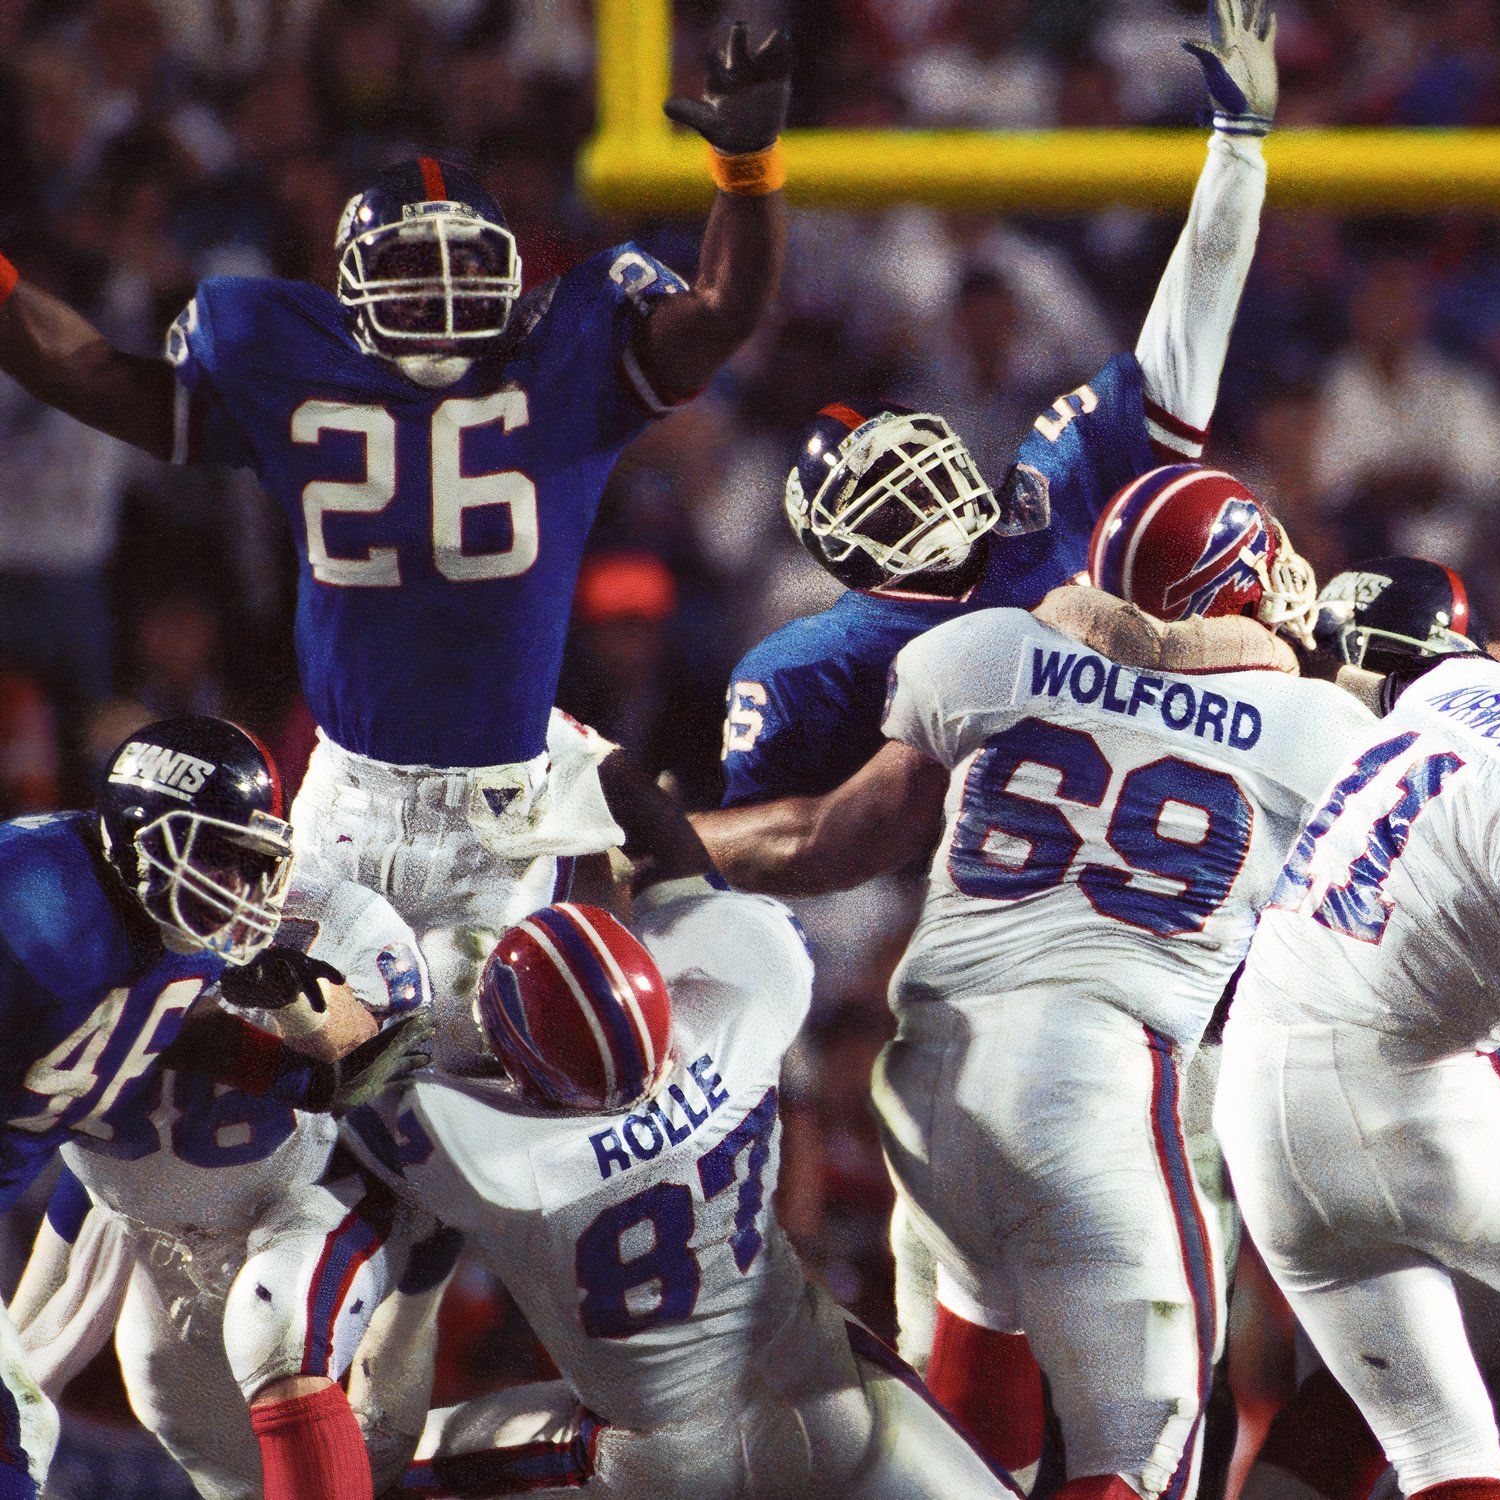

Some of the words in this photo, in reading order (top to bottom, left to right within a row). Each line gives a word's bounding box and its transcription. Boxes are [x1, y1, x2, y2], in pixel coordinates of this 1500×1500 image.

[291, 383, 540, 587] 26
[108, 741, 217, 801] GIANTS
[1031, 648, 1262, 751] WOLFORD
[947, 716, 1255, 938] 69
[1261, 730, 1467, 946] 11
[575, 1085, 779, 1339] 87
[588, 1053, 729, 1180] ROLLE
